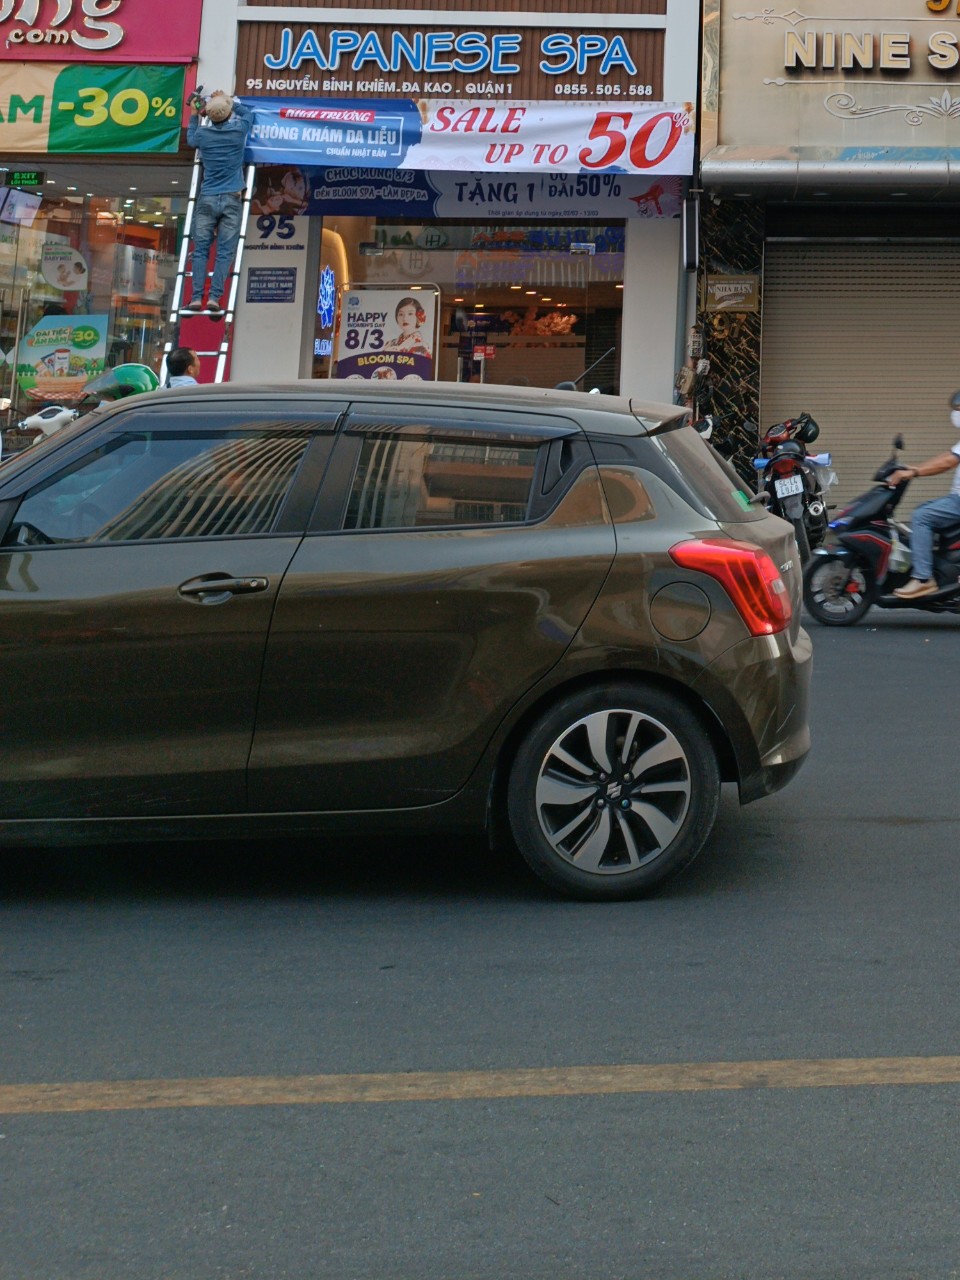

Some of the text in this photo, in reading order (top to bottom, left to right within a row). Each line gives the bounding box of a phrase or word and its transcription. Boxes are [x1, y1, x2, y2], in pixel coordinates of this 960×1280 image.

[264, 28, 637, 75] JAPANESE SPA
[784, 31, 912, 70] NINE
[246, 78, 263, 90] 95
[266, 75, 319, 91] NGUYỄN
[402, 82, 420, 93] ĐA
[424, 81, 452, 93] KAO
[0, 87, 176, 128] M -30%
[429, 106, 527, 134] SALE
[251, 122, 397, 146] PHÒNG KHÁM DA LIỄU
[484, 143, 569, 166] UP TO
[455, 177, 535, 207] TẶNG 1
[256, 215, 296, 240] 95
[347, 312, 388, 323] HAPPY
[344, 329, 385, 350] 8/3
[357, 354, 415, 366] BLOOM SPA
